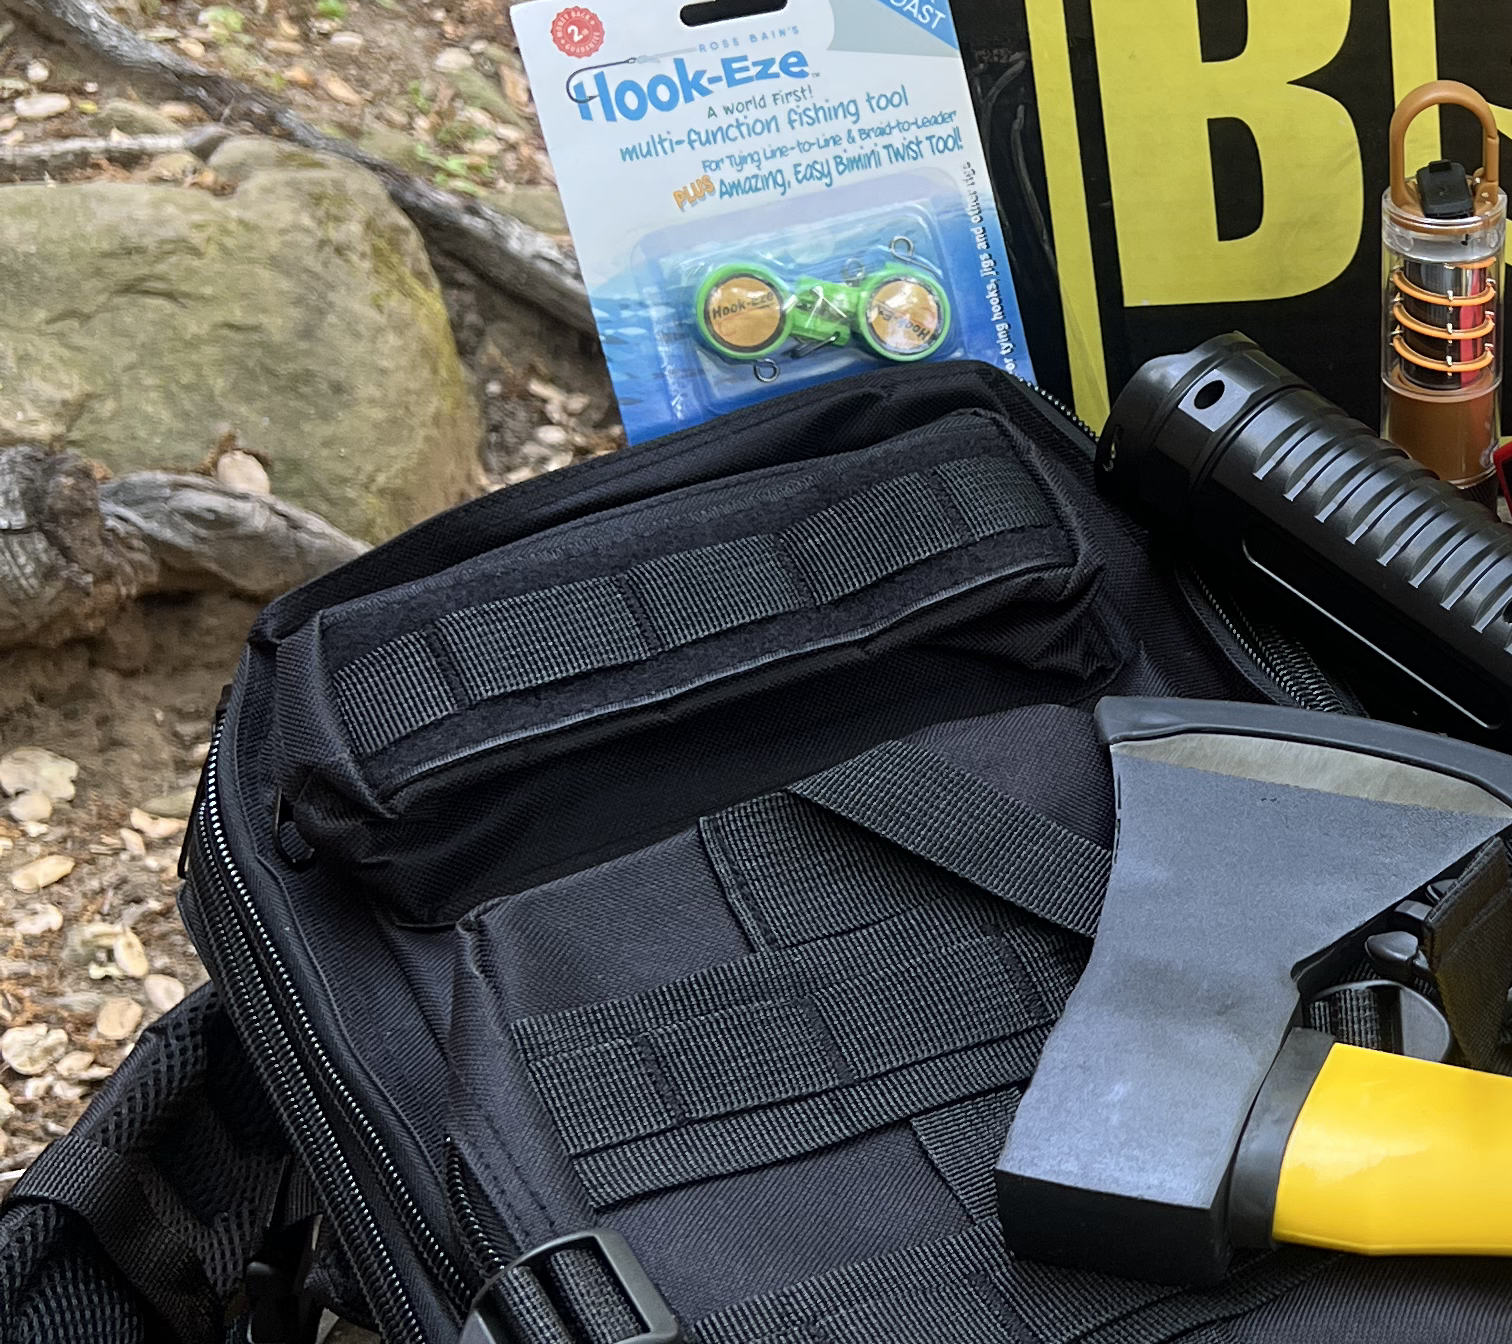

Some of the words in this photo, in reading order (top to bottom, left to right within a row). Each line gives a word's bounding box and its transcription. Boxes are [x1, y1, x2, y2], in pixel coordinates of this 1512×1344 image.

[698, 37, 739, 53] ROSS
[749, 25, 800, 44] BAIN'S
[573, 50, 810, 123] Hook-Eze
[707, 106, 718, 119] A
[772, 84, 814, 107] First!
[619, 114, 781, 162] multi-function
[786, 96, 861, 131] fishing
[865, 84, 909, 114] tool
[673, 174, 716, 212] PLUS
[719, 168, 792, 200] Amazing,
[792, 158, 833, 188] Easy
[833, 142, 882, 176] Bimini
[882, 135, 924, 165] Twist
[925, 125, 964, 156] Tool!
[702, 157, 724, 173] For
[725, 149, 762, 173] Tying
[763, 133, 843, 161] Line-to-Line
[846, 129, 856, 144] &
[970, 225, 990, 251] and
[995, 323, 1016, 356] tying
